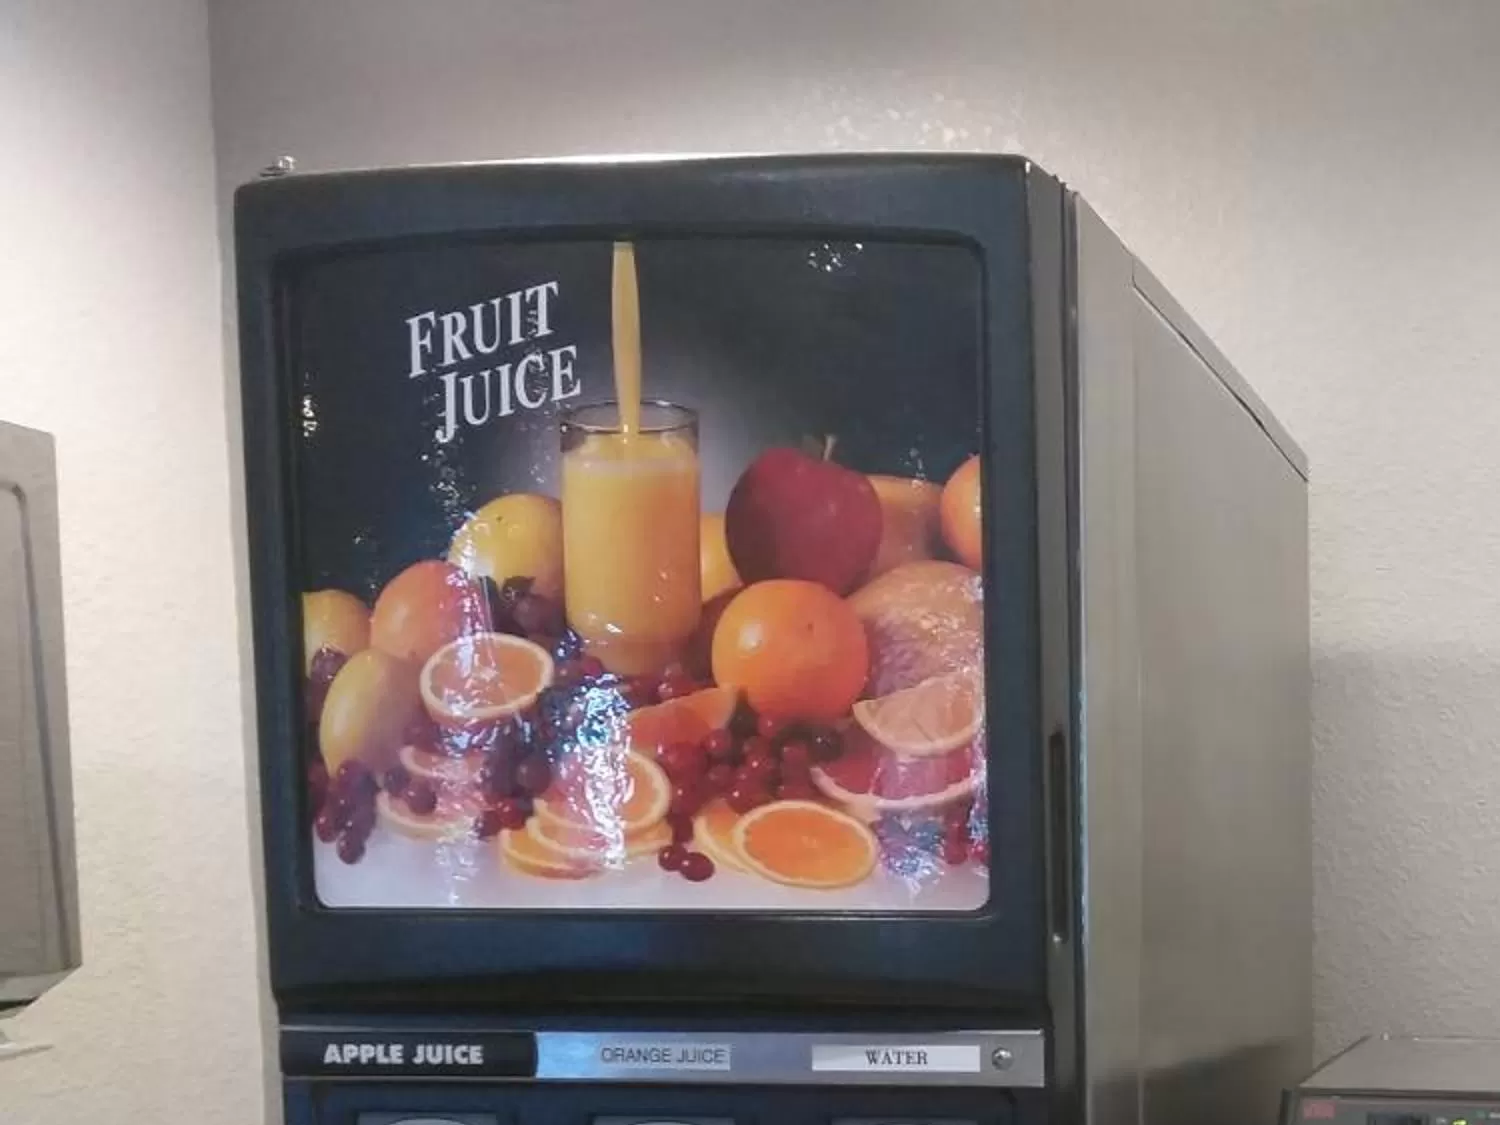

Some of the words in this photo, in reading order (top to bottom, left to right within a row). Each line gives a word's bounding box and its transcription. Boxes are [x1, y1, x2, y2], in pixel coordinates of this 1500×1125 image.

[405, 281, 560, 379] FRUIT
[434, 345, 582, 443] JUICE
[323, 1043, 405, 1065] APPLE
[412, 1044, 485, 1065] JUICE
[601, 1047, 672, 1064] ORANGE
[676, 1047, 726, 1065] JUICE
[865, 1049, 928, 1066] WATER
